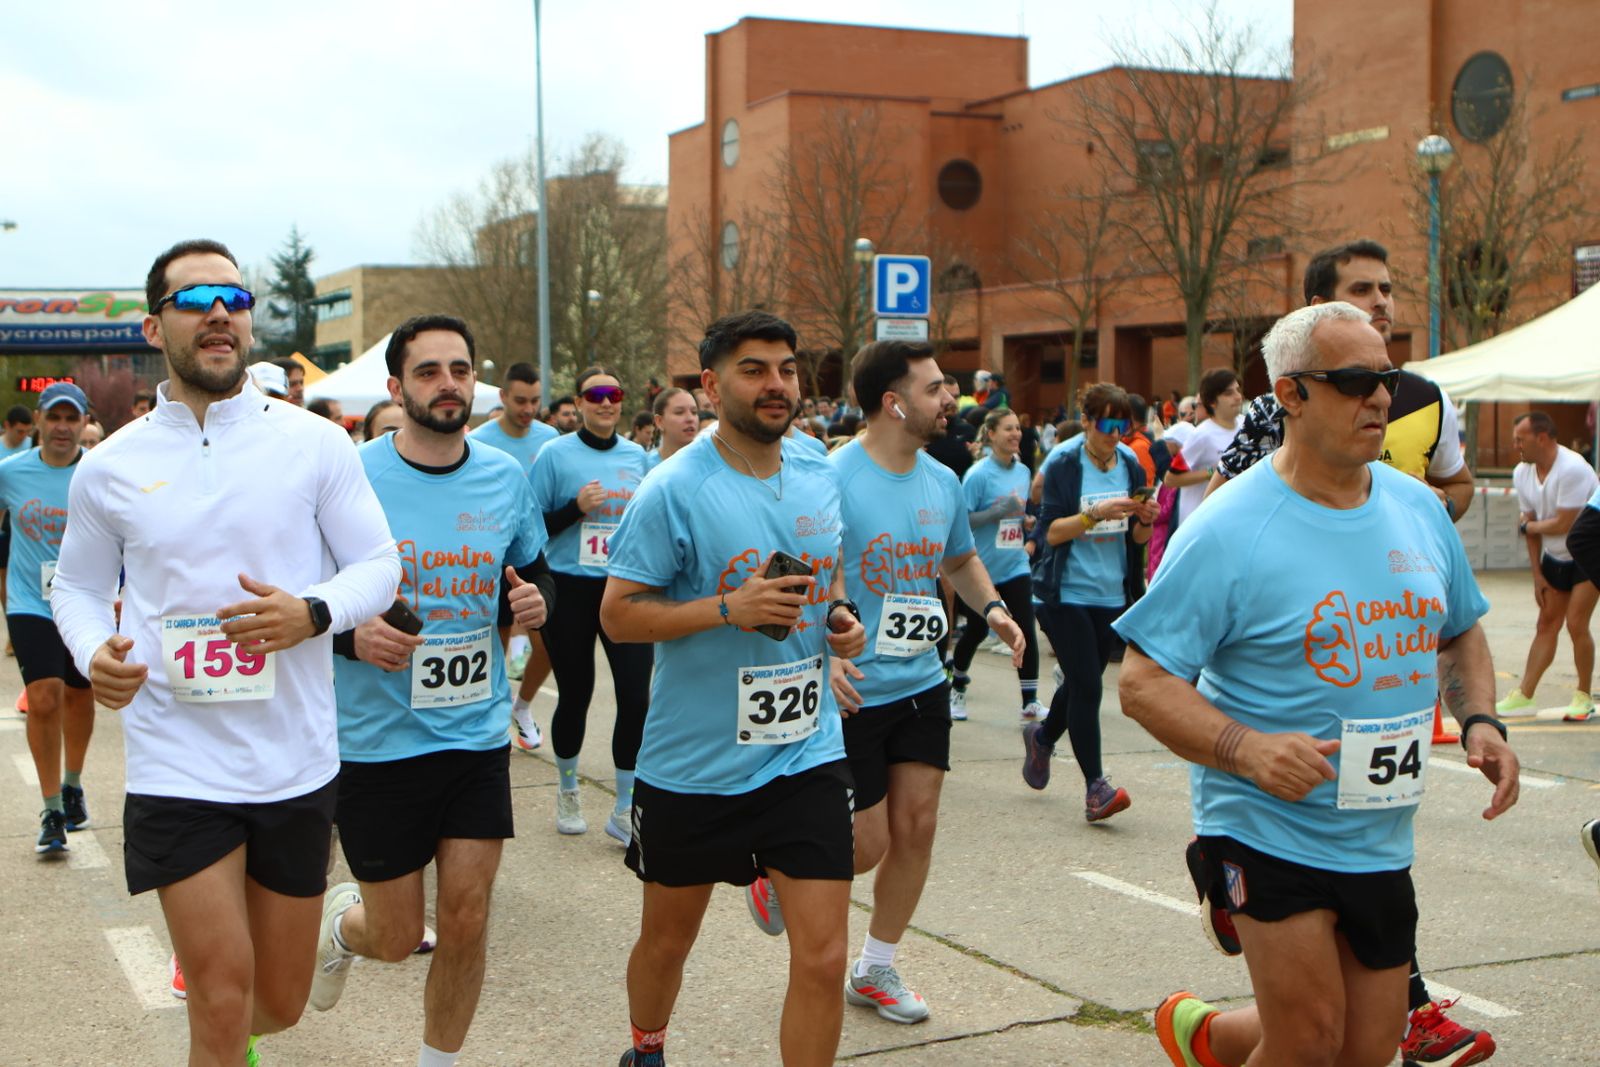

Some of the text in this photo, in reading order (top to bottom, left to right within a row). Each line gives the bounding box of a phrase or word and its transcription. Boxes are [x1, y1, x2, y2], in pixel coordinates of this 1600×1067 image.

[886, 262, 920, 308] P
[0, 291, 149, 319] ronSp
[421, 545, 495, 570] contra
[422, 576, 447, 598] el
[1355, 589, 1444, 626] contra
[885, 612, 944, 642] 329
[174, 639, 266, 680] 159
[1363, 633, 1391, 660] el
[421, 650, 488, 689] 302
[748, 680, 818, 725] 326
[1367, 739, 1421, 785] 54
